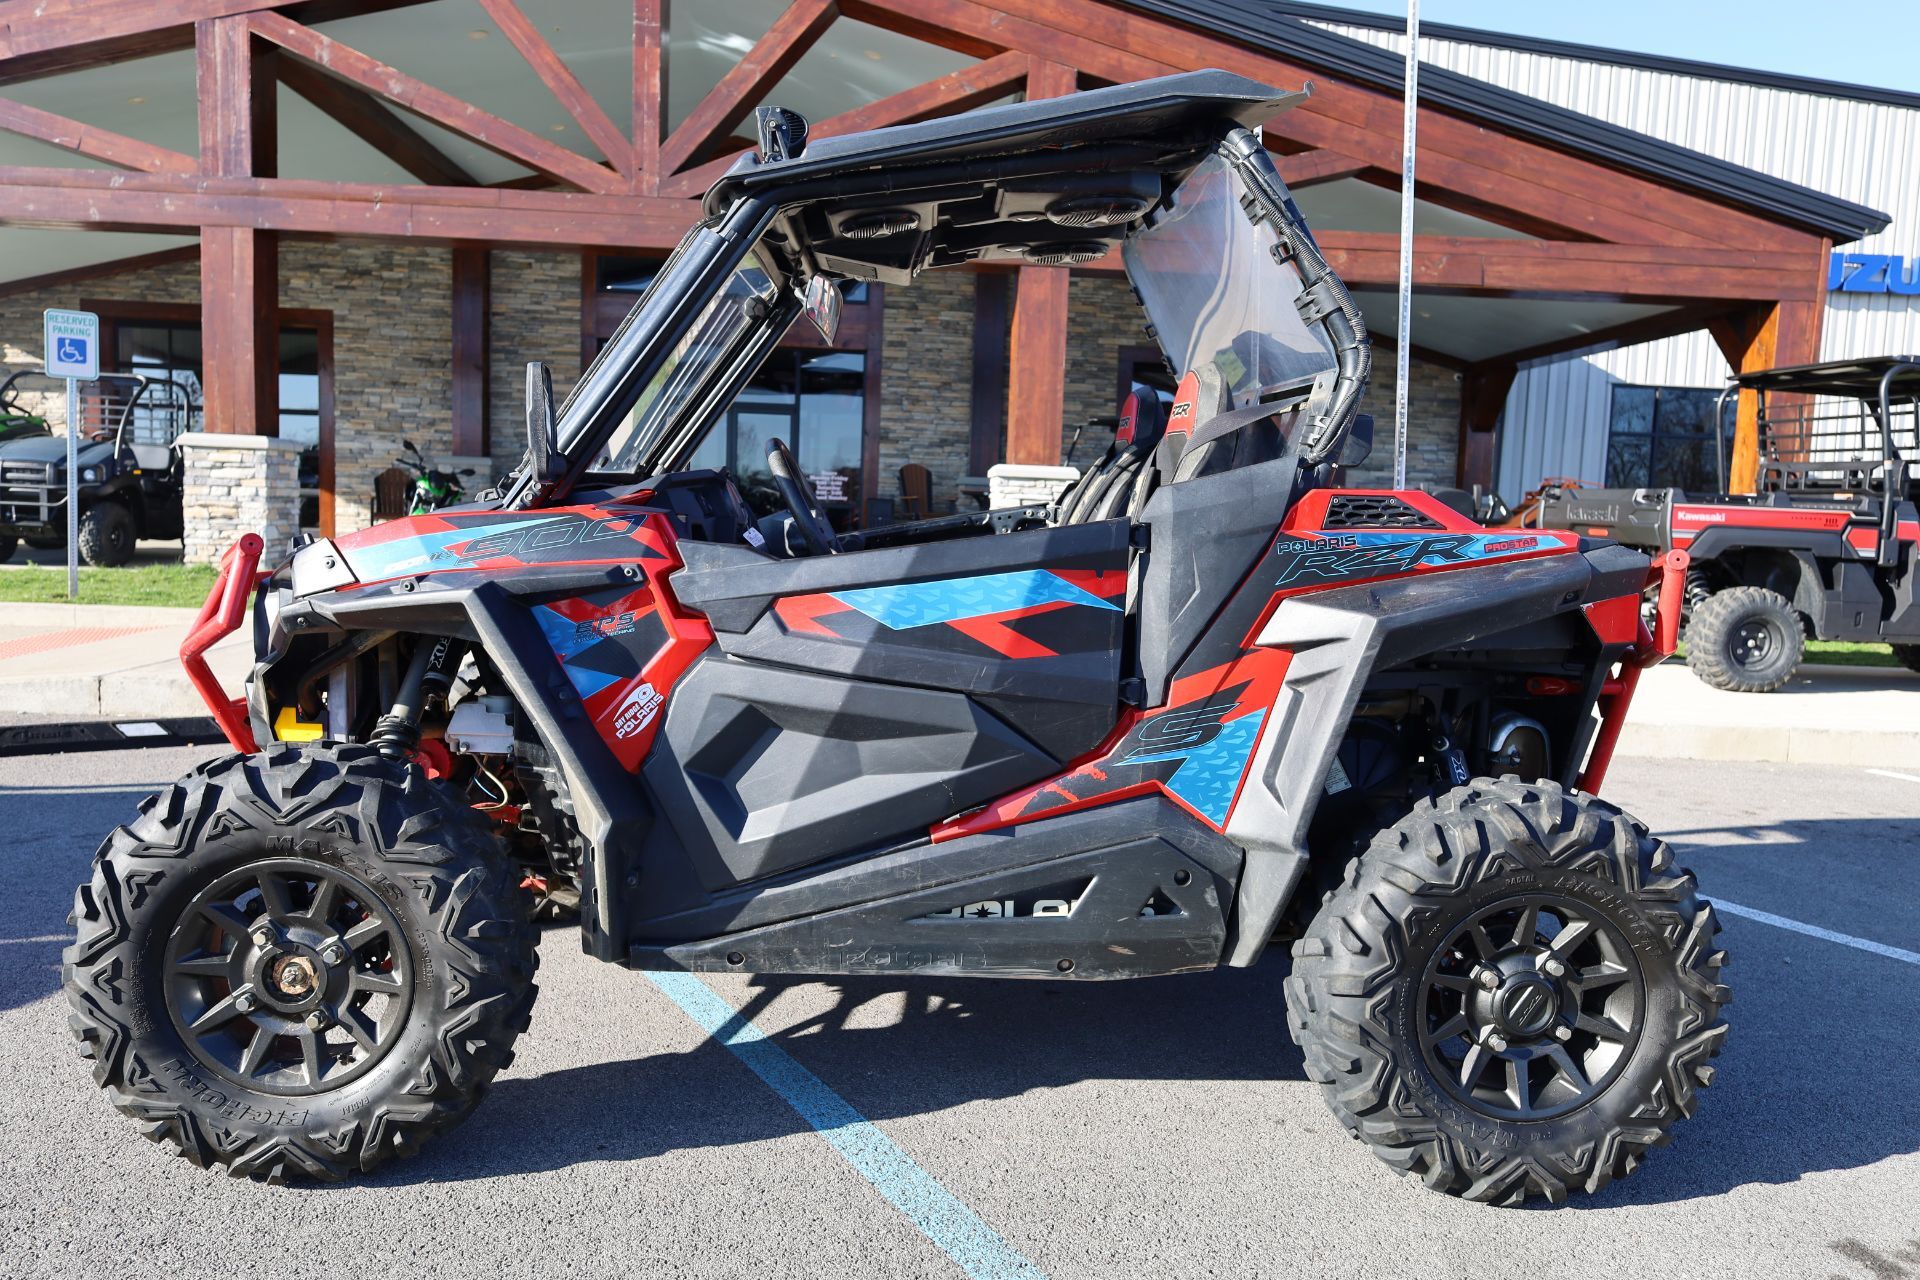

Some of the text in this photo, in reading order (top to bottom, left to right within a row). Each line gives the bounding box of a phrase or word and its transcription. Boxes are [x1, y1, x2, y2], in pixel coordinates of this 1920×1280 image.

[48, 314, 96, 327] RESERVED
[52, 325, 91, 337] PARKING
[1677, 511, 1726, 522] Kawasaki
[453, 513, 648, 566] 900
[1277, 535, 1357, 554] POLARIS
[1484, 538, 1538, 553] PROSTAR
[1275, 534, 1479, 586] RZR
[576, 611, 636, 635] EPS
[615, 716, 626, 729] DRY
[616, 693, 664, 739] POLARIS
[266, 835, 404, 901] MAXXIS
[1505, 875, 1536, 886] RADIAL
[340, 1096, 370, 1116] RADIAL
